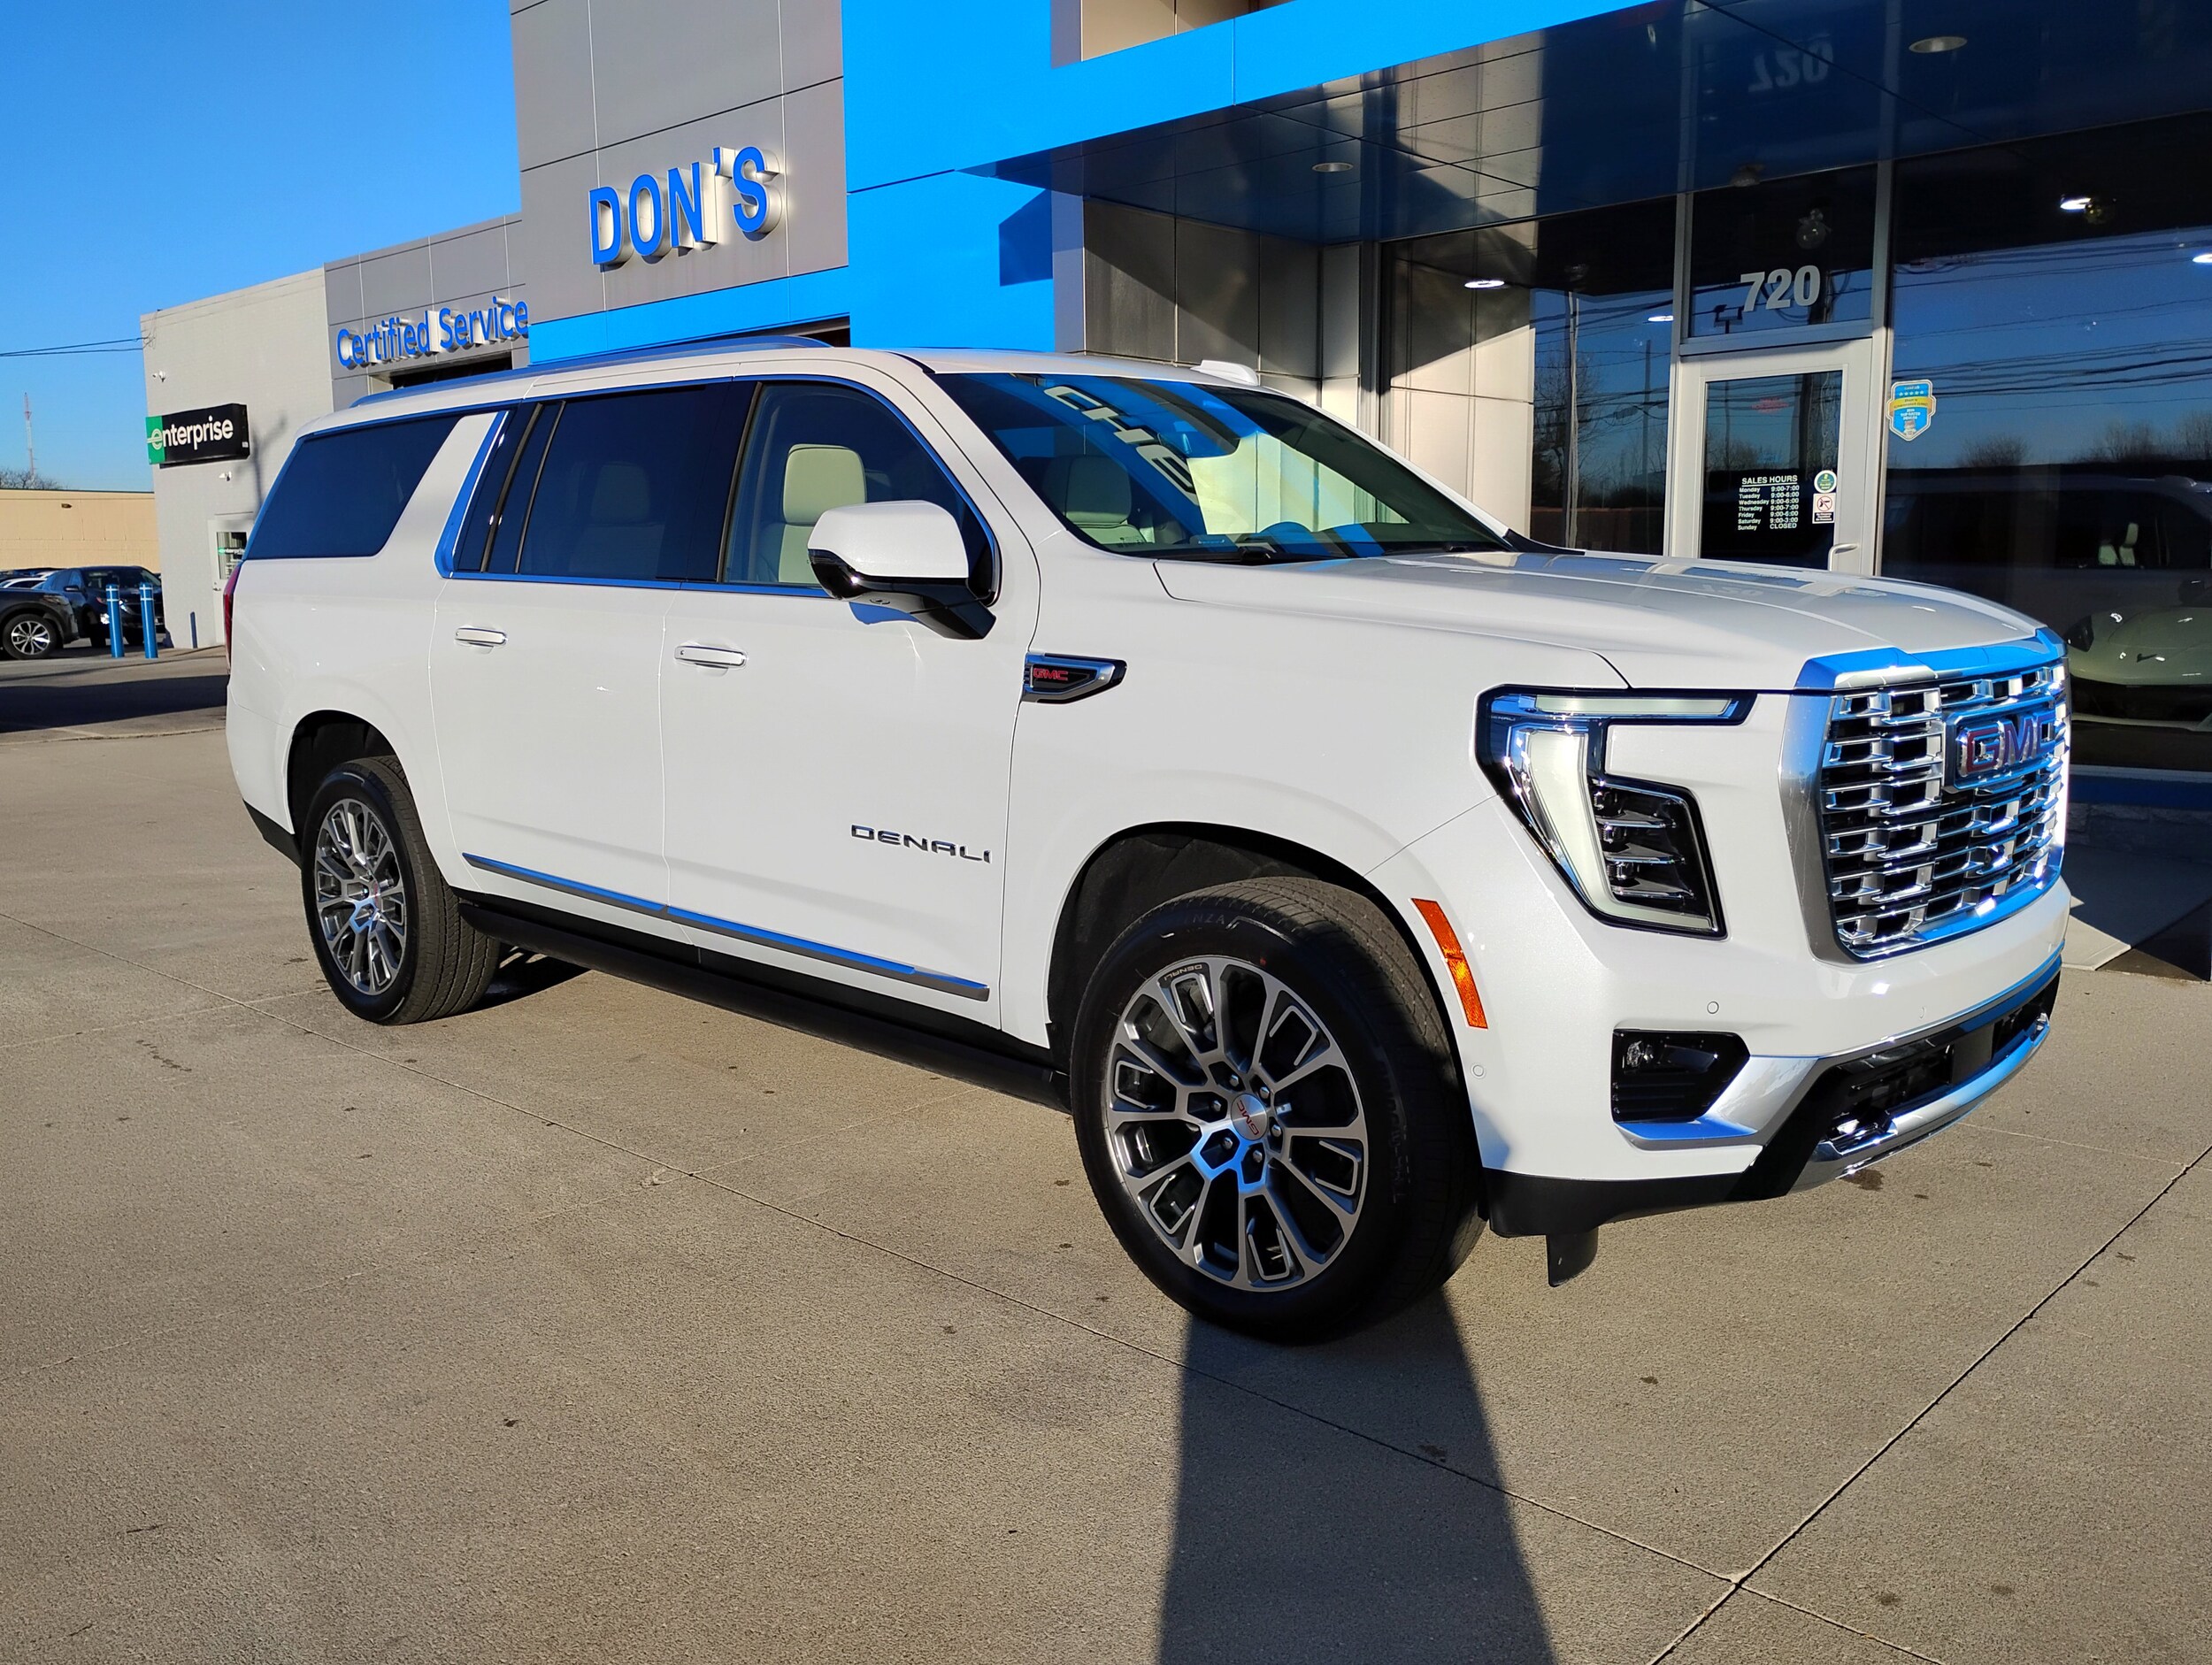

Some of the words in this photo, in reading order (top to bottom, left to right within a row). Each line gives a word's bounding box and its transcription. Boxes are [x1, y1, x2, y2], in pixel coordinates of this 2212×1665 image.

[588, 146, 769, 265] DON'S
[1740, 265, 1821, 312] 720
[337, 310, 430, 368] Certified
[439, 296, 529, 349] Service
[147, 415, 234, 450] enterprise
[1741, 476, 1768, 485] SALES
[1770, 474, 1798, 483] HOURS
[1033, 667, 1069, 680] GMC
[1962, 711, 2056, 774] GMC
[851, 825, 991, 863] DENALI
[1164, 963, 1202, 980] DENALI
[1237, 1100, 1260, 1135] GMC
